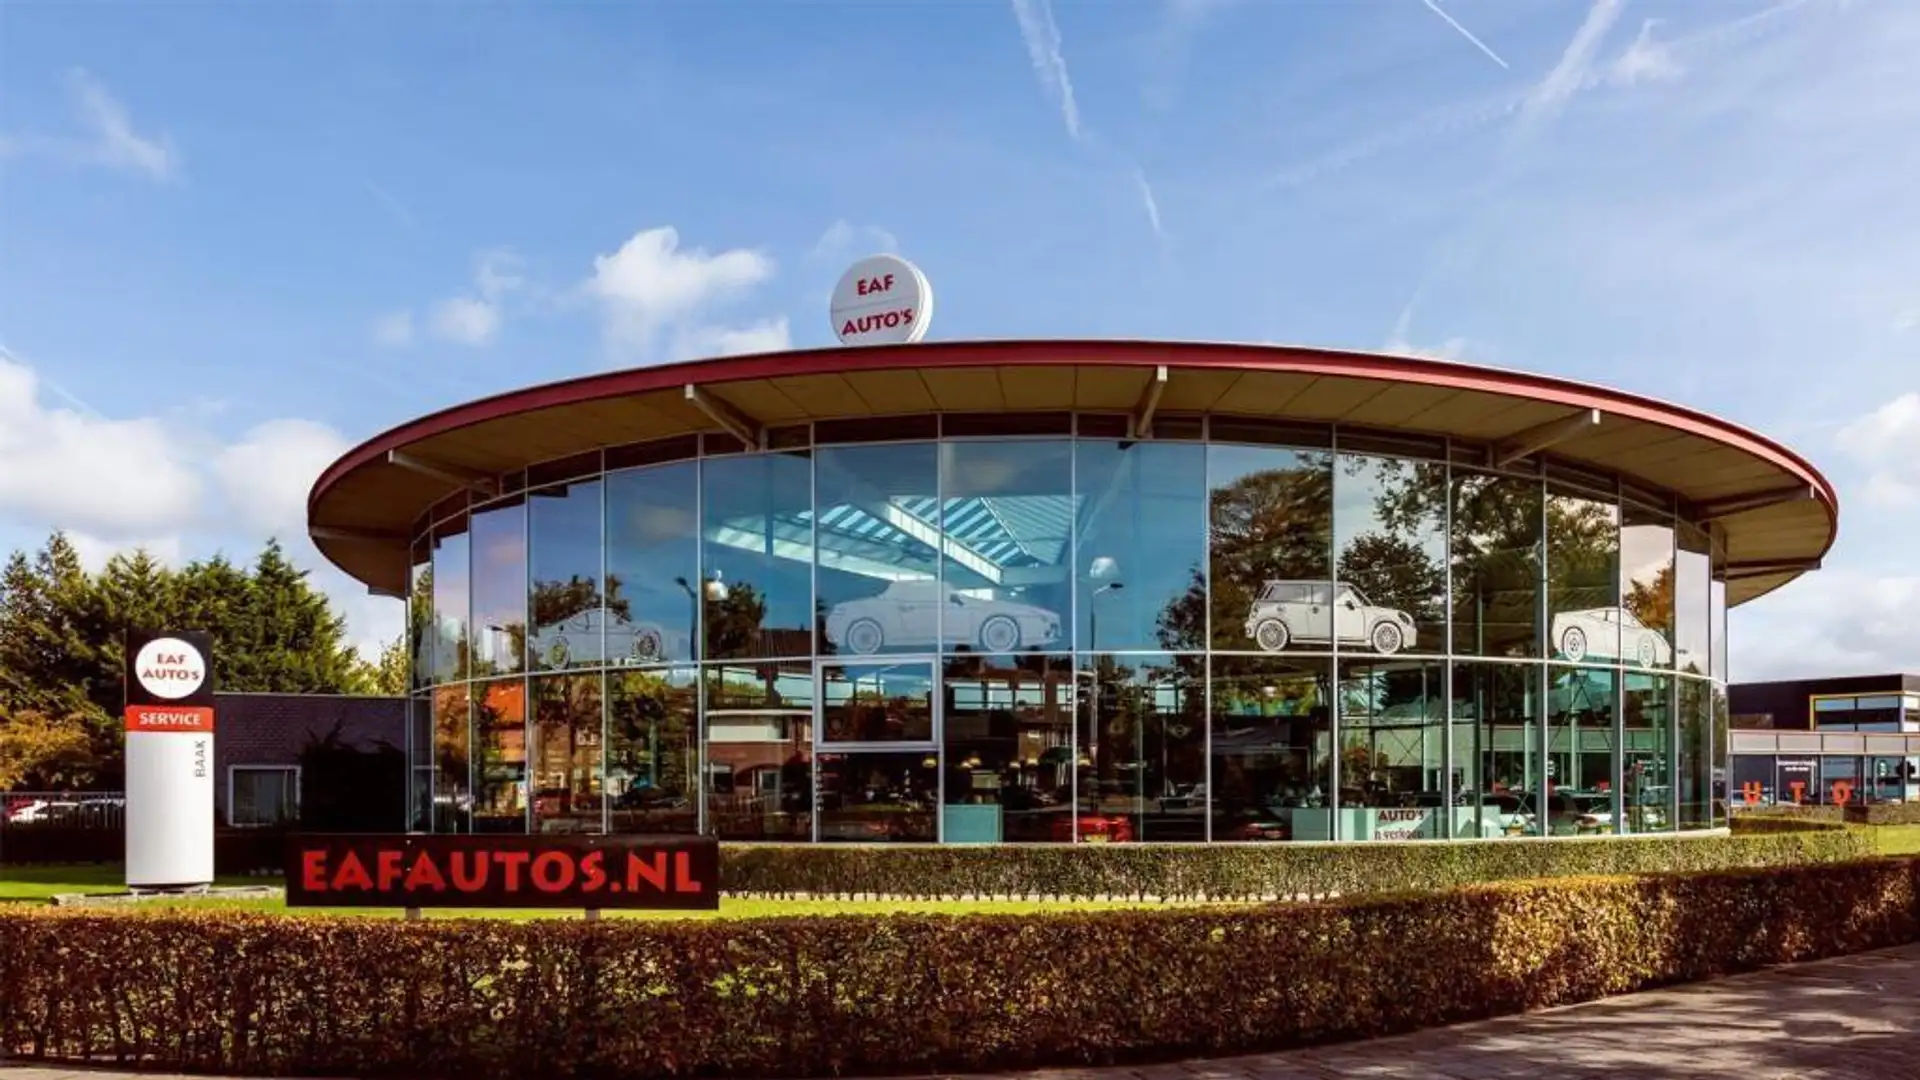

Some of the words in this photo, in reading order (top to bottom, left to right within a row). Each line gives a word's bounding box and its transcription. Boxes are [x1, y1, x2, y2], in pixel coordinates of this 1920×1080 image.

[857, 274, 894, 296] EAF
[842, 308, 913, 336] AUTO'S
[156, 653, 187, 665] EAF
[142, 668, 199, 681] AUTO'S
[139, 712, 201, 725] SERVICE
[195, 740, 206, 777] BAAK
[1378, 809, 1425, 822] AUTO'S
[303, 850, 702, 892] EAFAUTOS.NL
